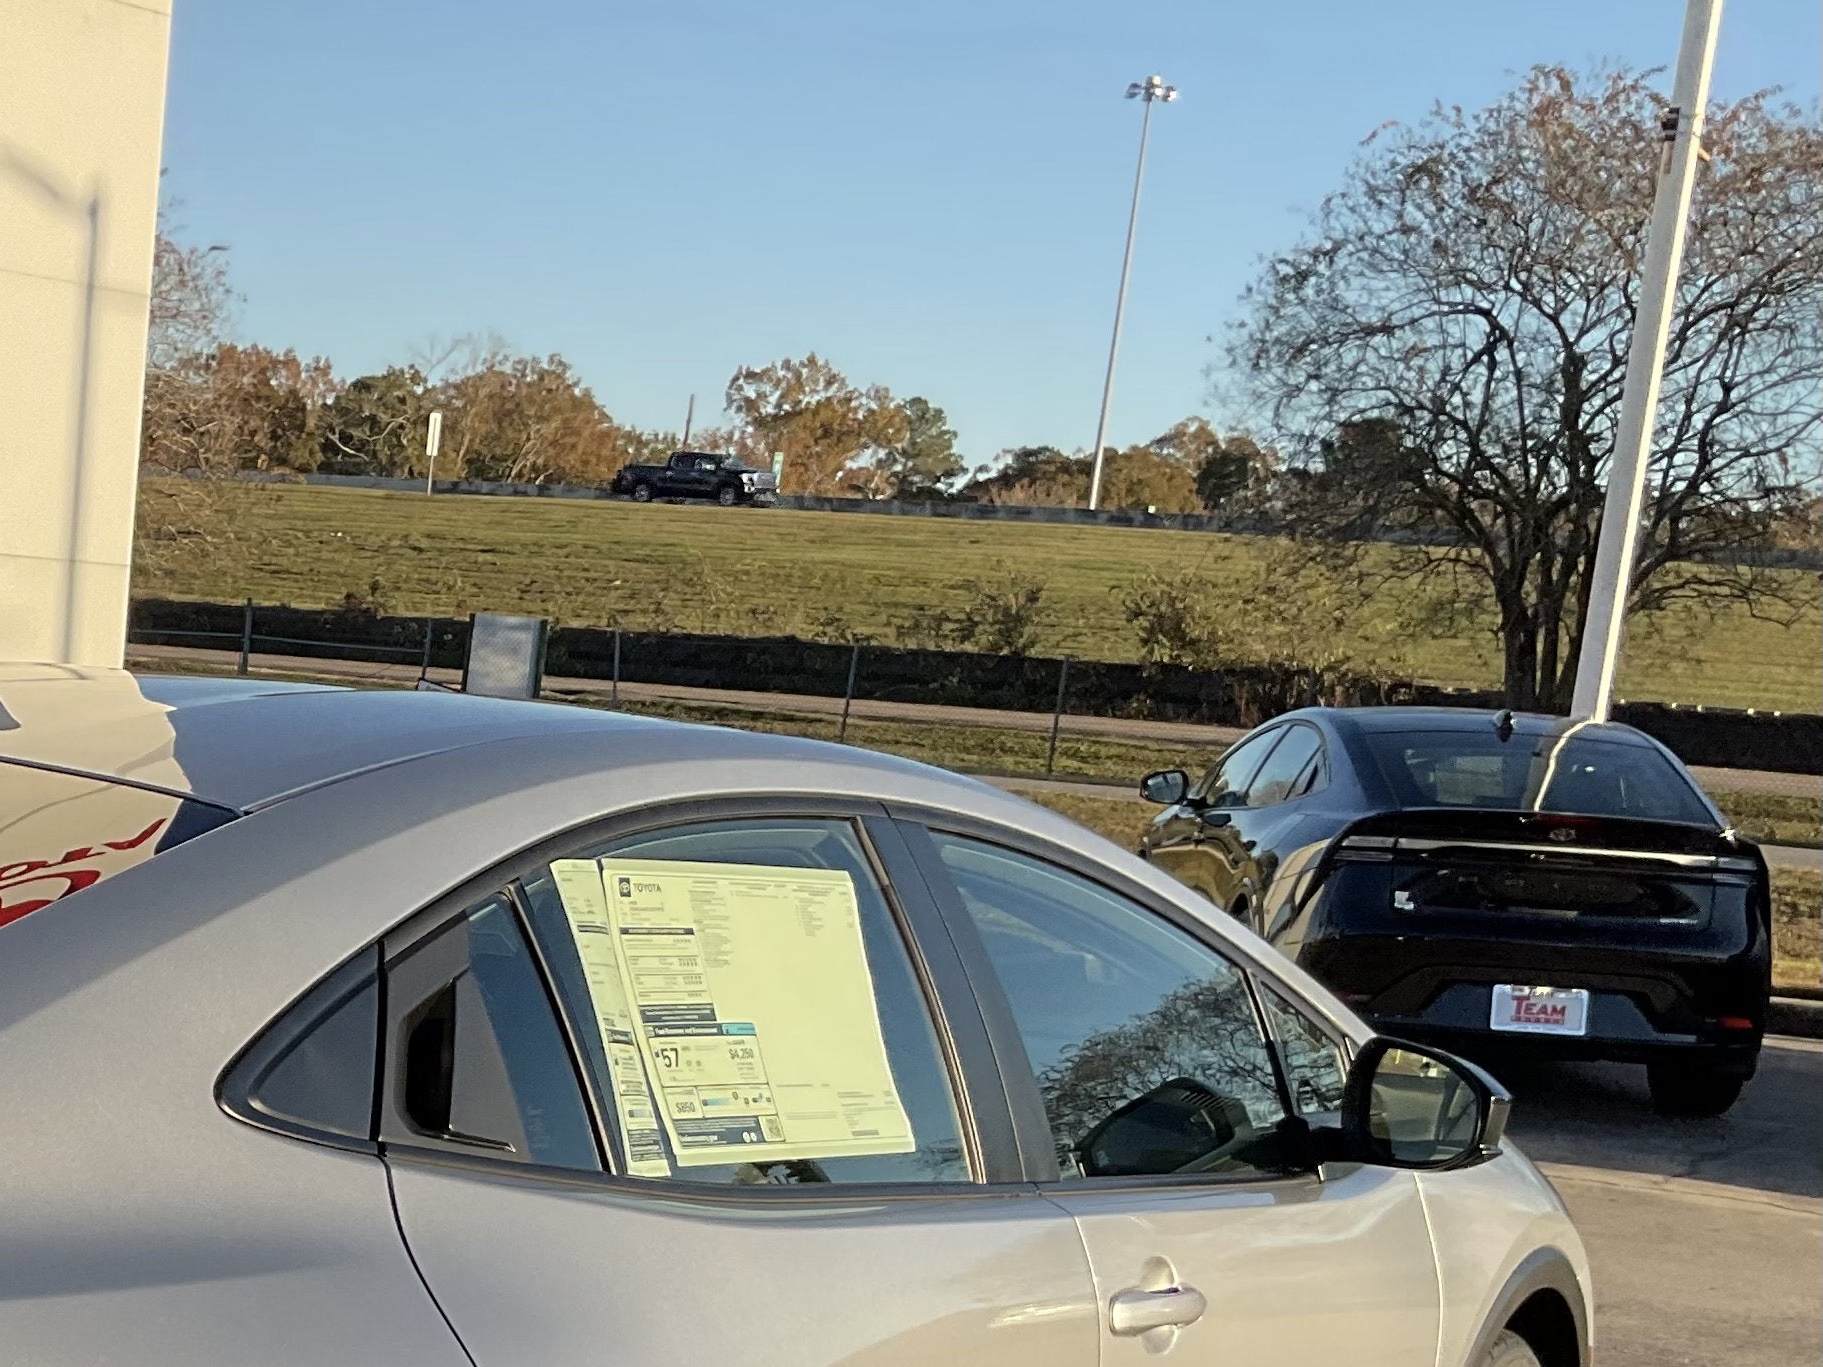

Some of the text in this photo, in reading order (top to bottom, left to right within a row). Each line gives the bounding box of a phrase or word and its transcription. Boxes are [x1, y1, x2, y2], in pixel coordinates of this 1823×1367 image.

[633, 882, 662, 893] TOYOTA
[1511, 995, 1566, 1018] TEAM
[660, 1047, 679, 1068] 57
